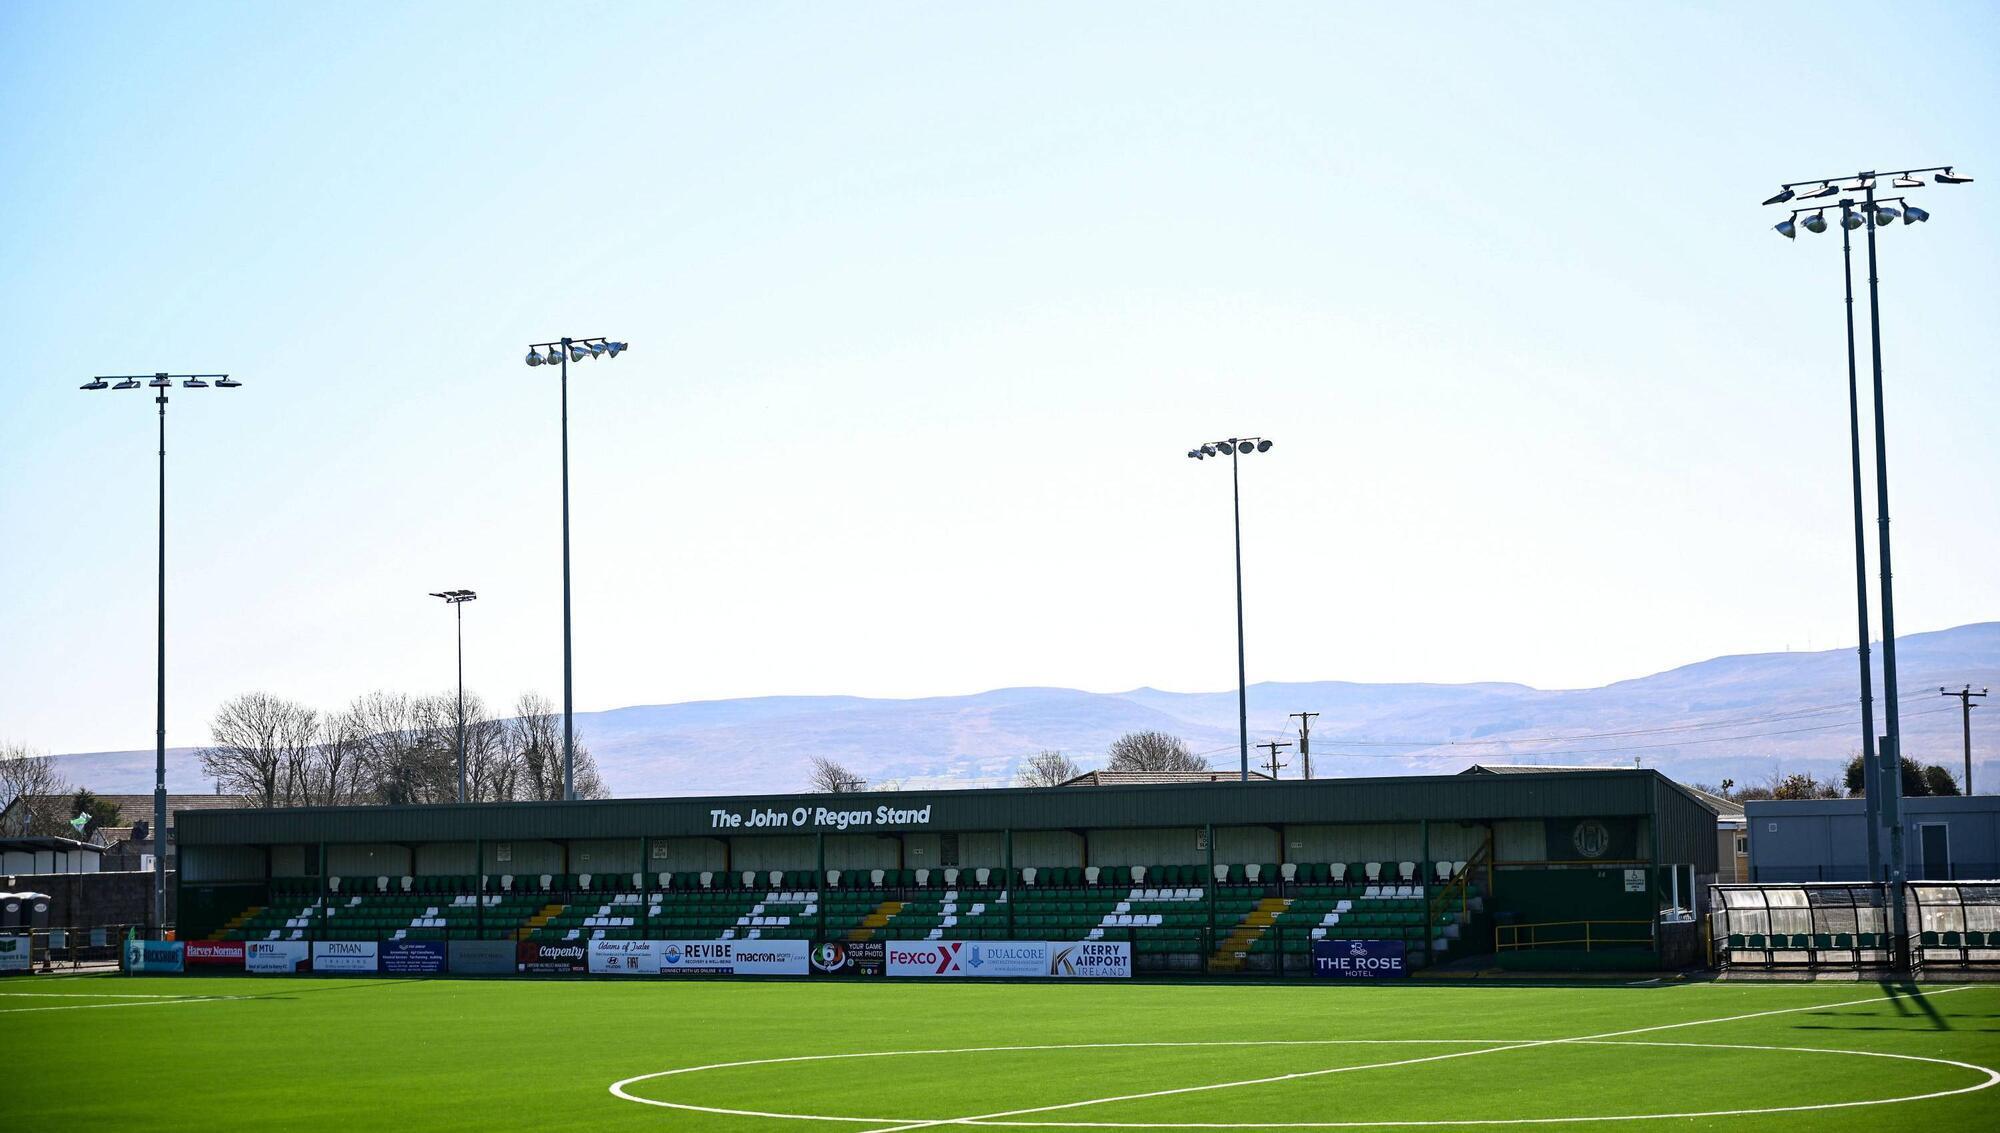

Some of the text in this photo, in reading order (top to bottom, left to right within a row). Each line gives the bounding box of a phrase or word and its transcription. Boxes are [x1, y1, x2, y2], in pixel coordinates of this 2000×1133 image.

[710, 810, 741, 828] The
[744, 808, 788, 827] John
[814, 807, 872, 830] Regan
[875, 805, 931, 825] Stand
[187, 945, 242, 958] Harvey Norman
[259, 944, 274, 953] MTU
[328, 943, 362, 954] PITMAN
[598, 941, 650, 952] Adams of Tralee
[684, 944, 732, 957] REVIBE
[1082, 944, 1120, 955] KERRY
[539, 945, 585, 960] Carpentry
[736, 952, 776, 963] macron
[865, 950, 884, 958] PHOTO
[890, 951, 937, 964] Fexco
[988, 949, 1044, 959] DUALCORE
[627, 956, 639, 969] FIAT
[1075, 956, 1127, 966] AIRPORT
[1317, 957, 1402, 969] THE ROSE
[1078, 967, 1125, 976] IRELAND
